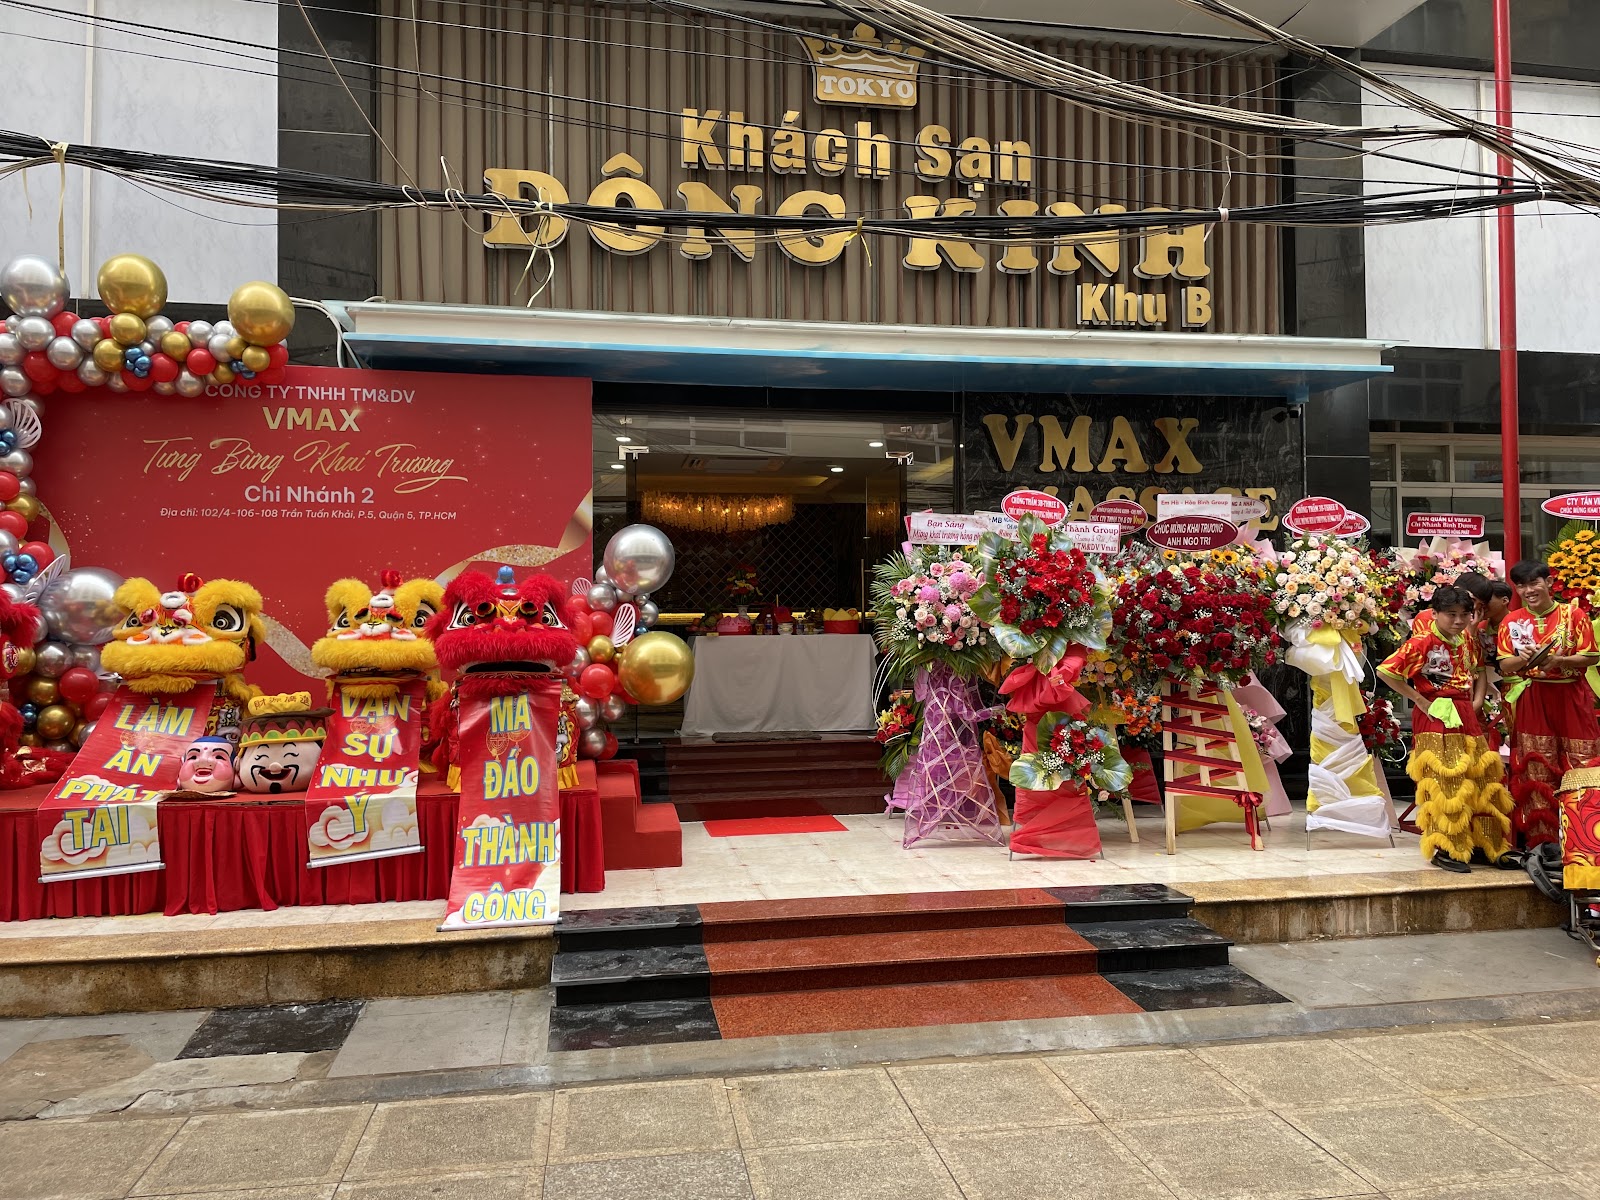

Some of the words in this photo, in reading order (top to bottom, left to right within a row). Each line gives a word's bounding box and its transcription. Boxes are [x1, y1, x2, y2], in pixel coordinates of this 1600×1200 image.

[820, 75, 914, 98] TOKYO
[681, 108, 892, 179] Khách
[914, 124, 1032, 197] Sạn
[903, 195, 1211, 280] KINH
[1077, 282, 1167, 326] Khu
[1181, 286, 1212, 327] B
[266, 385, 291, 399] TY
[295, 386, 345, 401] TNHH
[350, 388, 416, 403] TM&DV
[262, 407, 361, 432] VMAX
[982, 413, 1204, 474] VMAX
[294, 440, 371, 476] Khai
[374, 443, 469, 494] Trương
[244, 485, 280, 503] Chi
[287, 485, 355, 504] Nhánh
[361, 487, 374, 504] 2
[160, 507, 178, 518] Địa
[200, 508, 279, 518] 102/4-106-108
[358, 510, 376, 521] P.5,
[379, 510, 405, 522] Quận
[407, 511, 416, 521] 5,
[419, 511, 456, 520] TP.HCM
[991, 516, 1003, 524] MB
[1092, 525, 1119, 535] Group
[1166, 537, 1181, 546] ANH
[113, 697, 195, 737] LÀM
[341, 692, 412, 724] VẠN
[103, 743, 163, 778] ĂN
[342, 728, 399, 763] SỰ
[320, 765, 410, 788] NHƯ
[483, 747, 541, 801] ĐÁO
[344, 790, 371, 834] Ý
[461, 813, 558, 869] THÀNH
[463, 881, 547, 924] CÔNG
